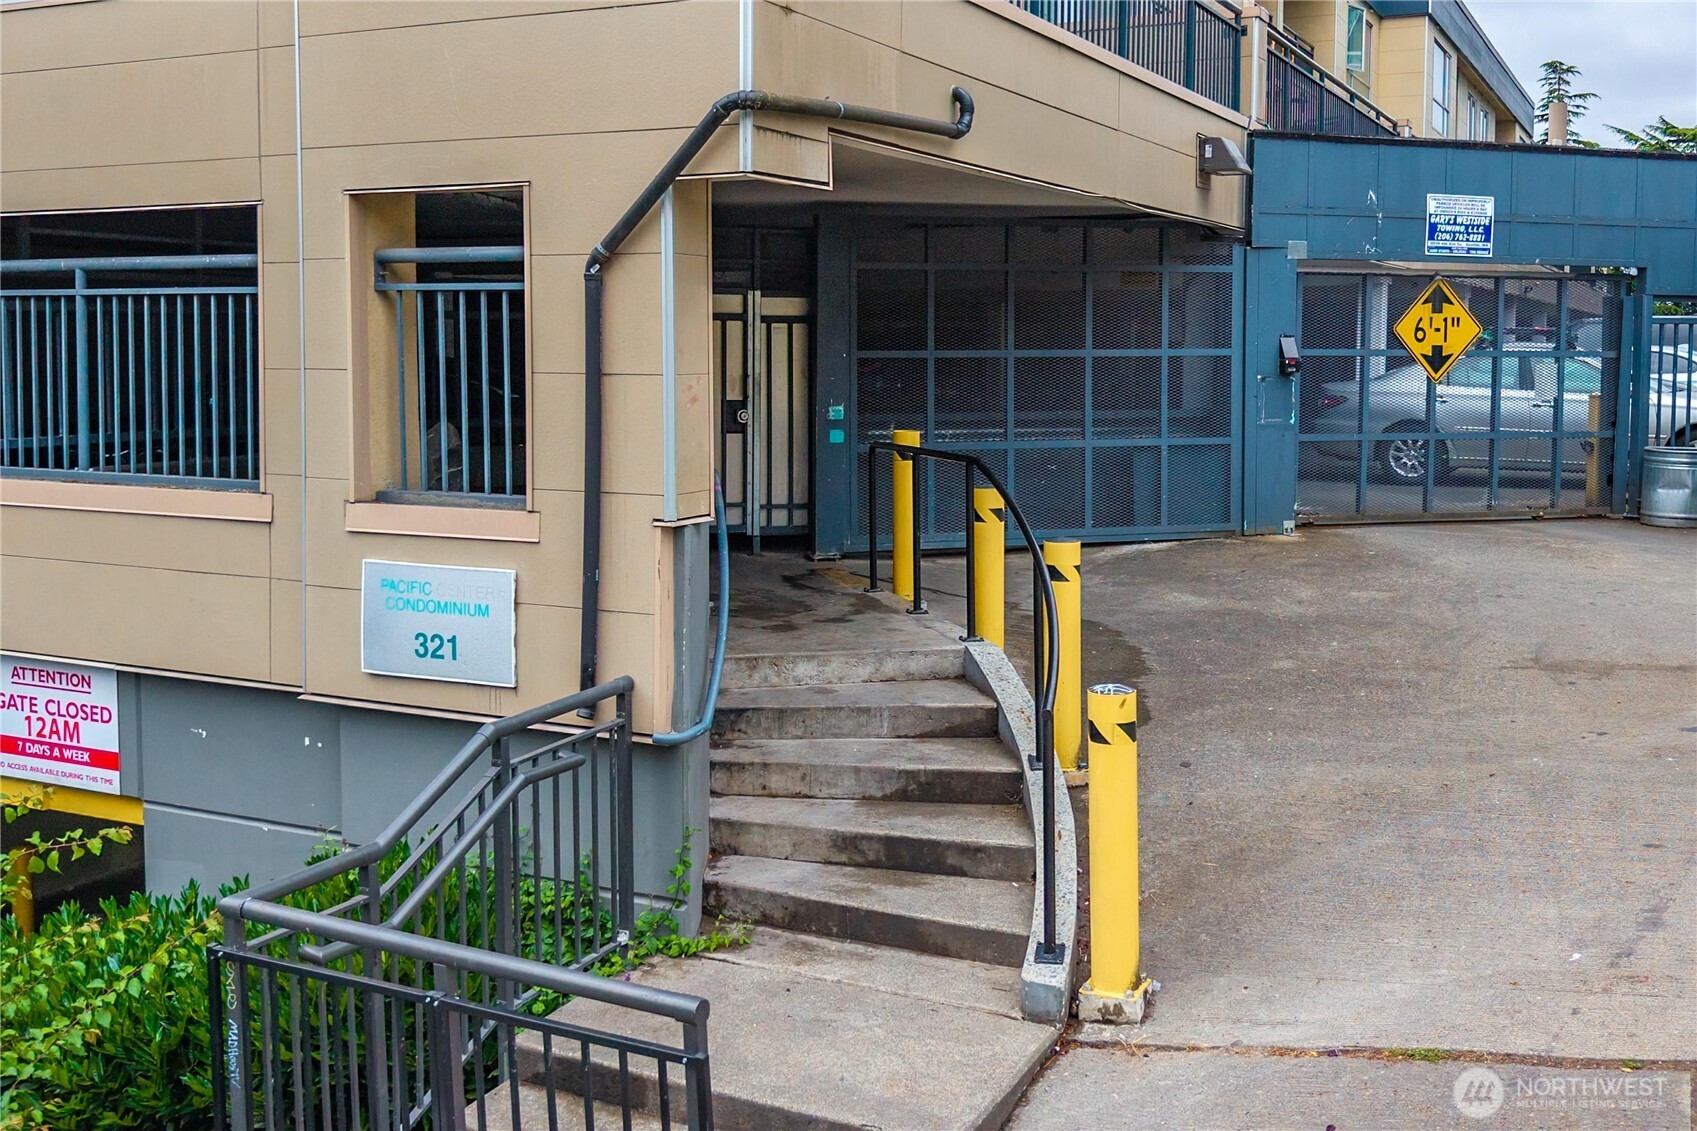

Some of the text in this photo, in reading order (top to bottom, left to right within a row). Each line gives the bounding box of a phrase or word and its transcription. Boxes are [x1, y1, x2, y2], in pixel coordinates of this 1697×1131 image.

[1430, 215, 1490, 226] GARY'S WESTSIDE
[1437, 225, 1466, 233] TOWING,
[1434, 232, 1453, 240] (206)
[381, 578, 432, 596] PACIFIC
[386, 596, 490, 618] CONDOMINIUM
[414, 632, 457, 660] 321
[11, 666, 91, 689] ATTENTION
[45, 699, 112, 724] CLOSED
[24, 715, 81, 744] 12AM
[17, 741, 90, 763] 7 DAYS A WEEK
[7, 762, 28, 771] ACCESS
[29, 766, 59, 776] AVAILABLE
[61, 771, 83, 780] DURING
[100, 777, 113, 785] TIME
